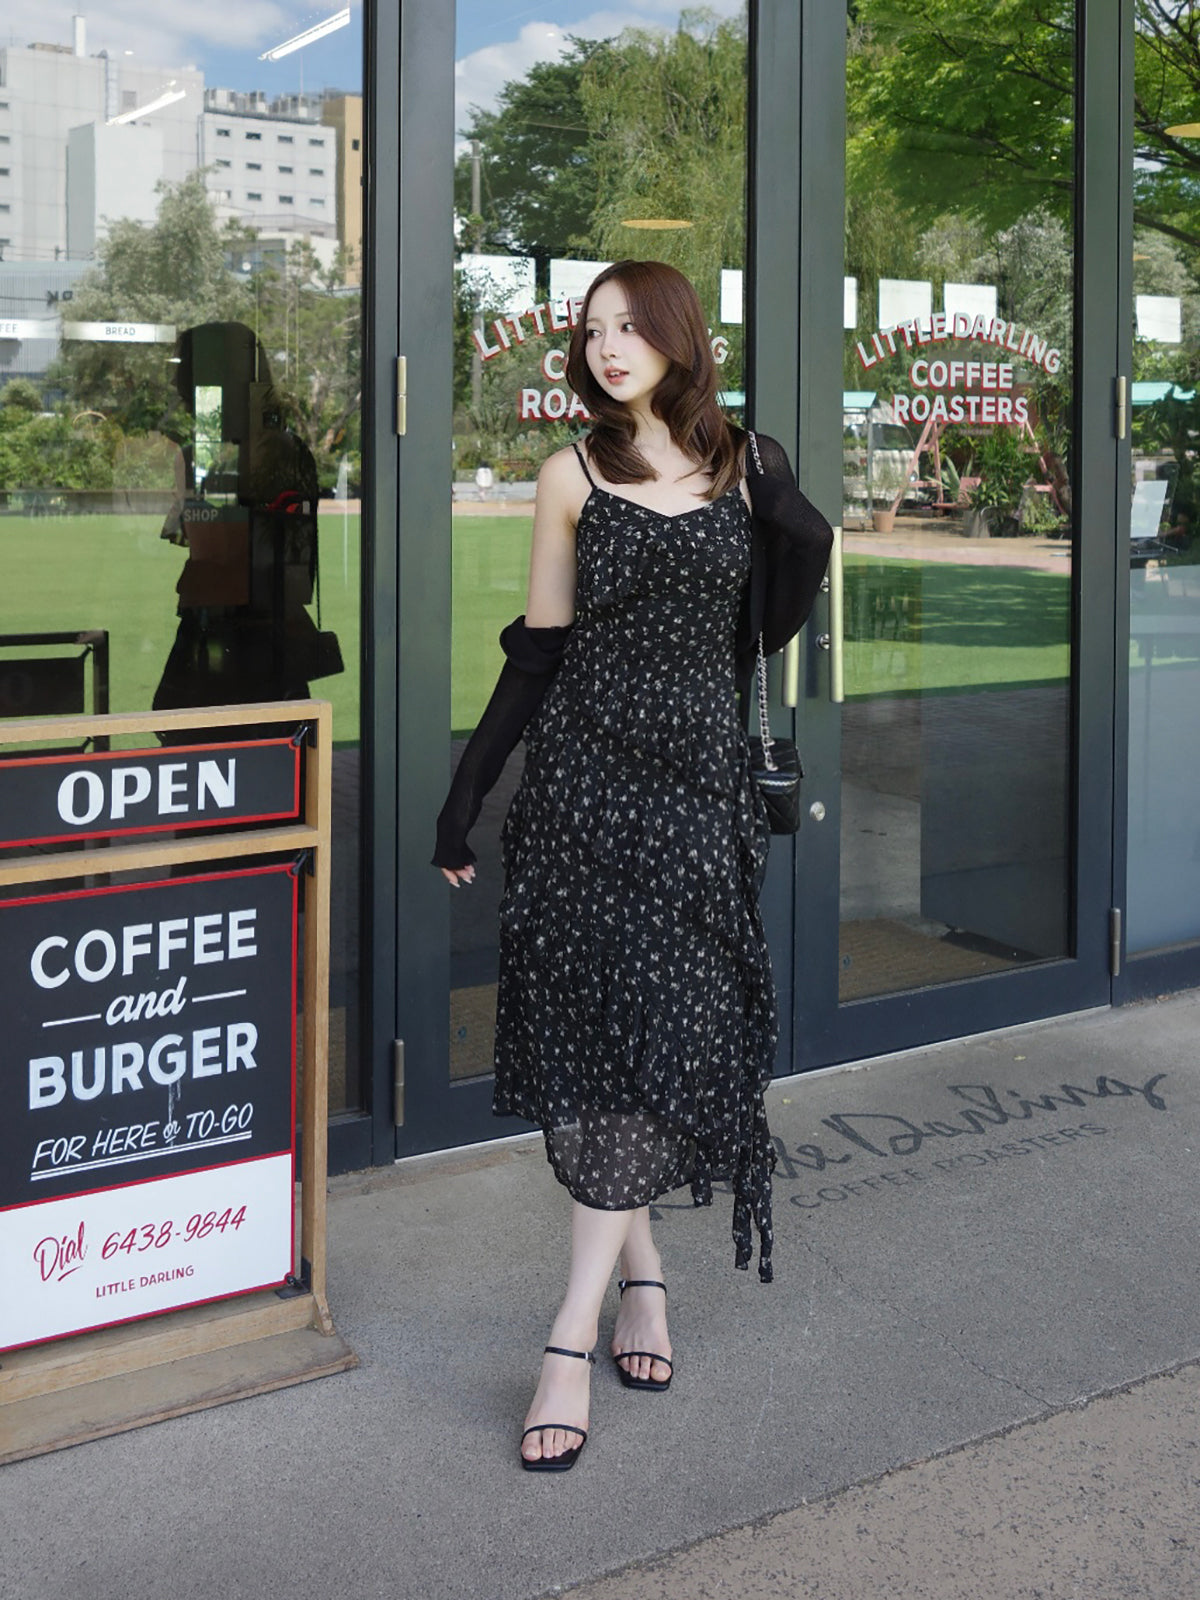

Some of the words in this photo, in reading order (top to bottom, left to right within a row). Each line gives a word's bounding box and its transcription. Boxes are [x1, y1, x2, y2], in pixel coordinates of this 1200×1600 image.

[105, 326, 136, 336] BREAD
[856, 312, 947, 371] LITTLE
[953, 312, 1061, 375] DARLING
[910, 359, 1013, 390] COFFEE
[892, 394, 1028, 424] ROASTERS
[184, 509, 218, 521] SHOP
[57, 758, 236, 826] OPEN
[30, 908, 258, 989] COFFEE
[105, 976, 187, 1026] and
[29, 1021, 258, 1110] BURGER
[32, 1135, 87, 1169] FOR
[91, 1120, 160, 1157] HERE
[186, 1102, 254, 1139] TO-GO
[789, 1164, 927, 1209] COFFEE
[932, 1122, 1108, 1172] ROASTERS
[33, 1221, 88, 1281] Dial
[100, 1205, 248, 1260] 6438-9844
[95, 1279, 136, 1298] LITTLE
[139, 1265, 195, 1288] DARLING
